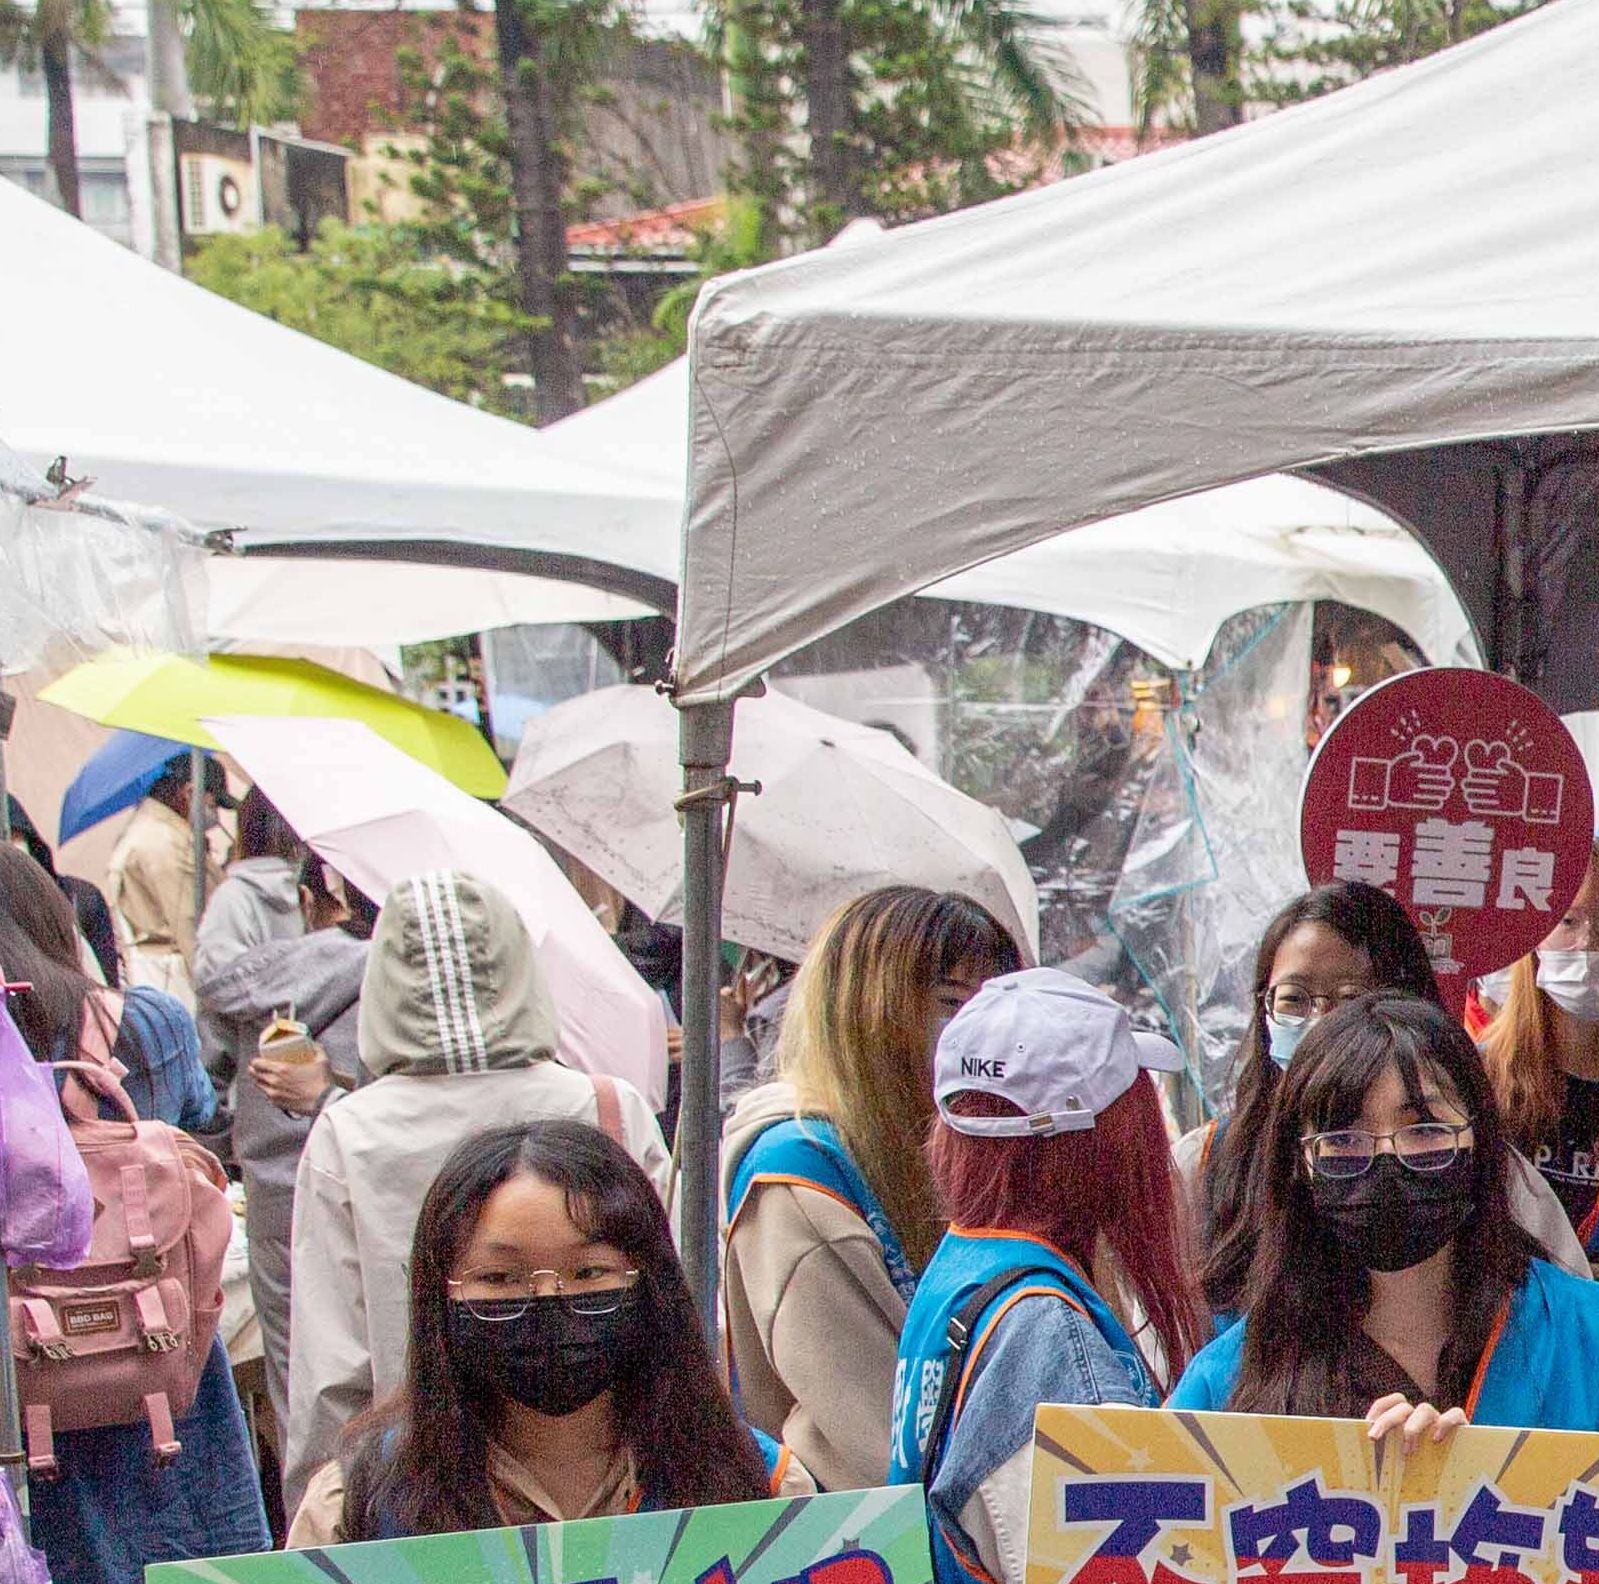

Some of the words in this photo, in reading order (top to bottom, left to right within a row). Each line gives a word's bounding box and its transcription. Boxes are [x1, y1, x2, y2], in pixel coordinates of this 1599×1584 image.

[1334, 818, 1556, 913] 要善良
[960, 1056, 1007, 1079] NIKE
